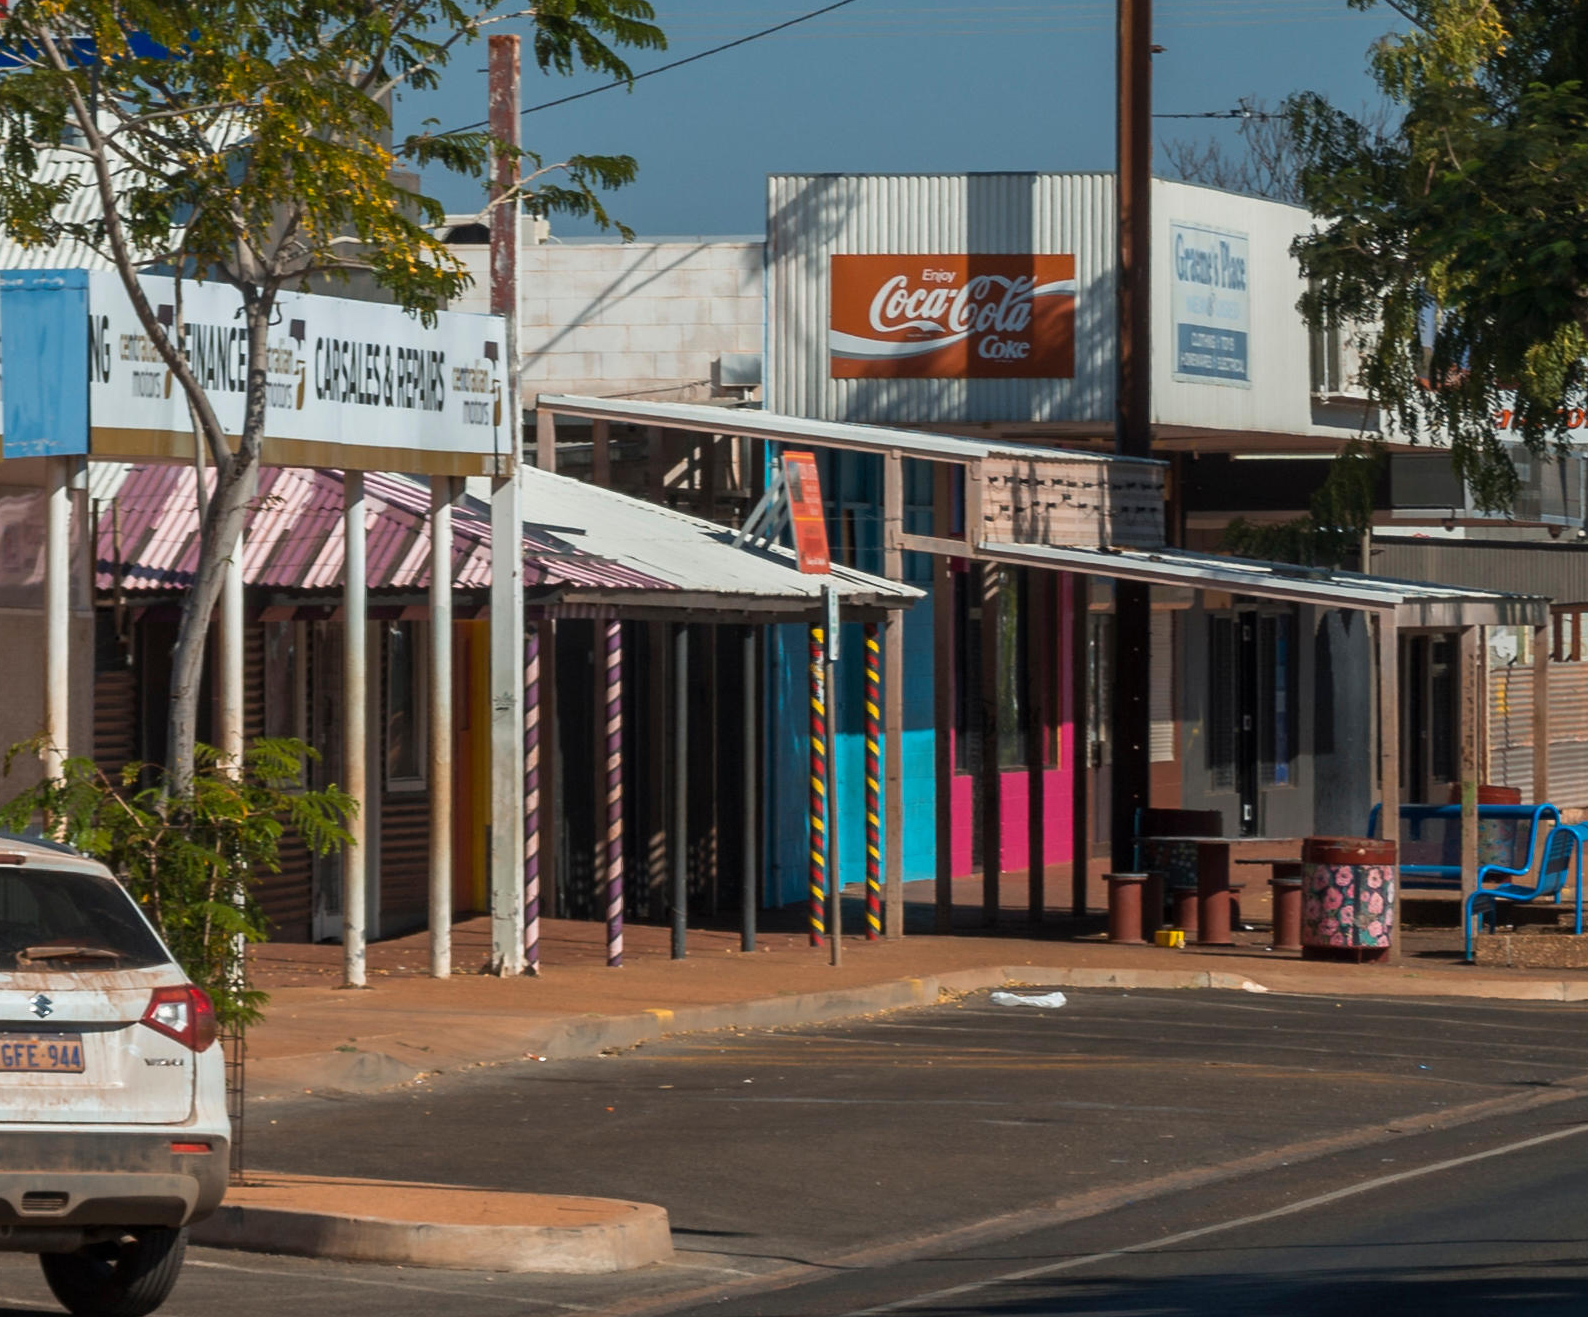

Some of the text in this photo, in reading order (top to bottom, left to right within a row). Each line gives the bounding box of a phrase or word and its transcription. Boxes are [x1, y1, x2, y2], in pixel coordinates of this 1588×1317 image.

[921, 268, 957, 284] Enjoy
[869, 274, 1038, 334] Coca-Cola
[978, 335, 1032, 360] Coke
[315, 337, 445, 413] CAR SALES & REPAIRS
